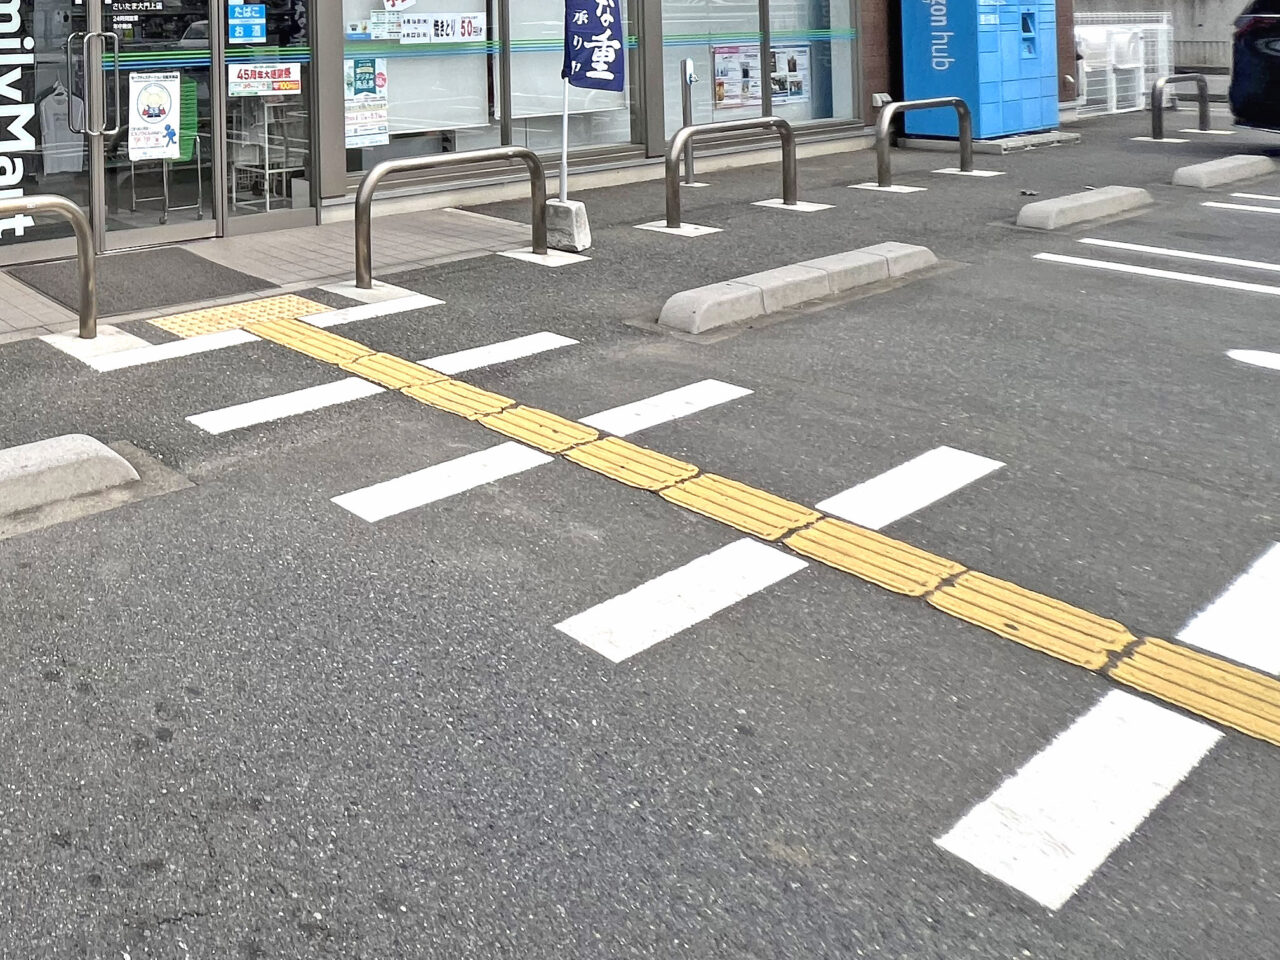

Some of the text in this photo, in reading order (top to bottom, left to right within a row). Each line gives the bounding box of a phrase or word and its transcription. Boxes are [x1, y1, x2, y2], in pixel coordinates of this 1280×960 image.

[233, 6, 260, 17] たばこ
[234, 24, 261, 37] お酒
[931, 31, 956, 71] hub
